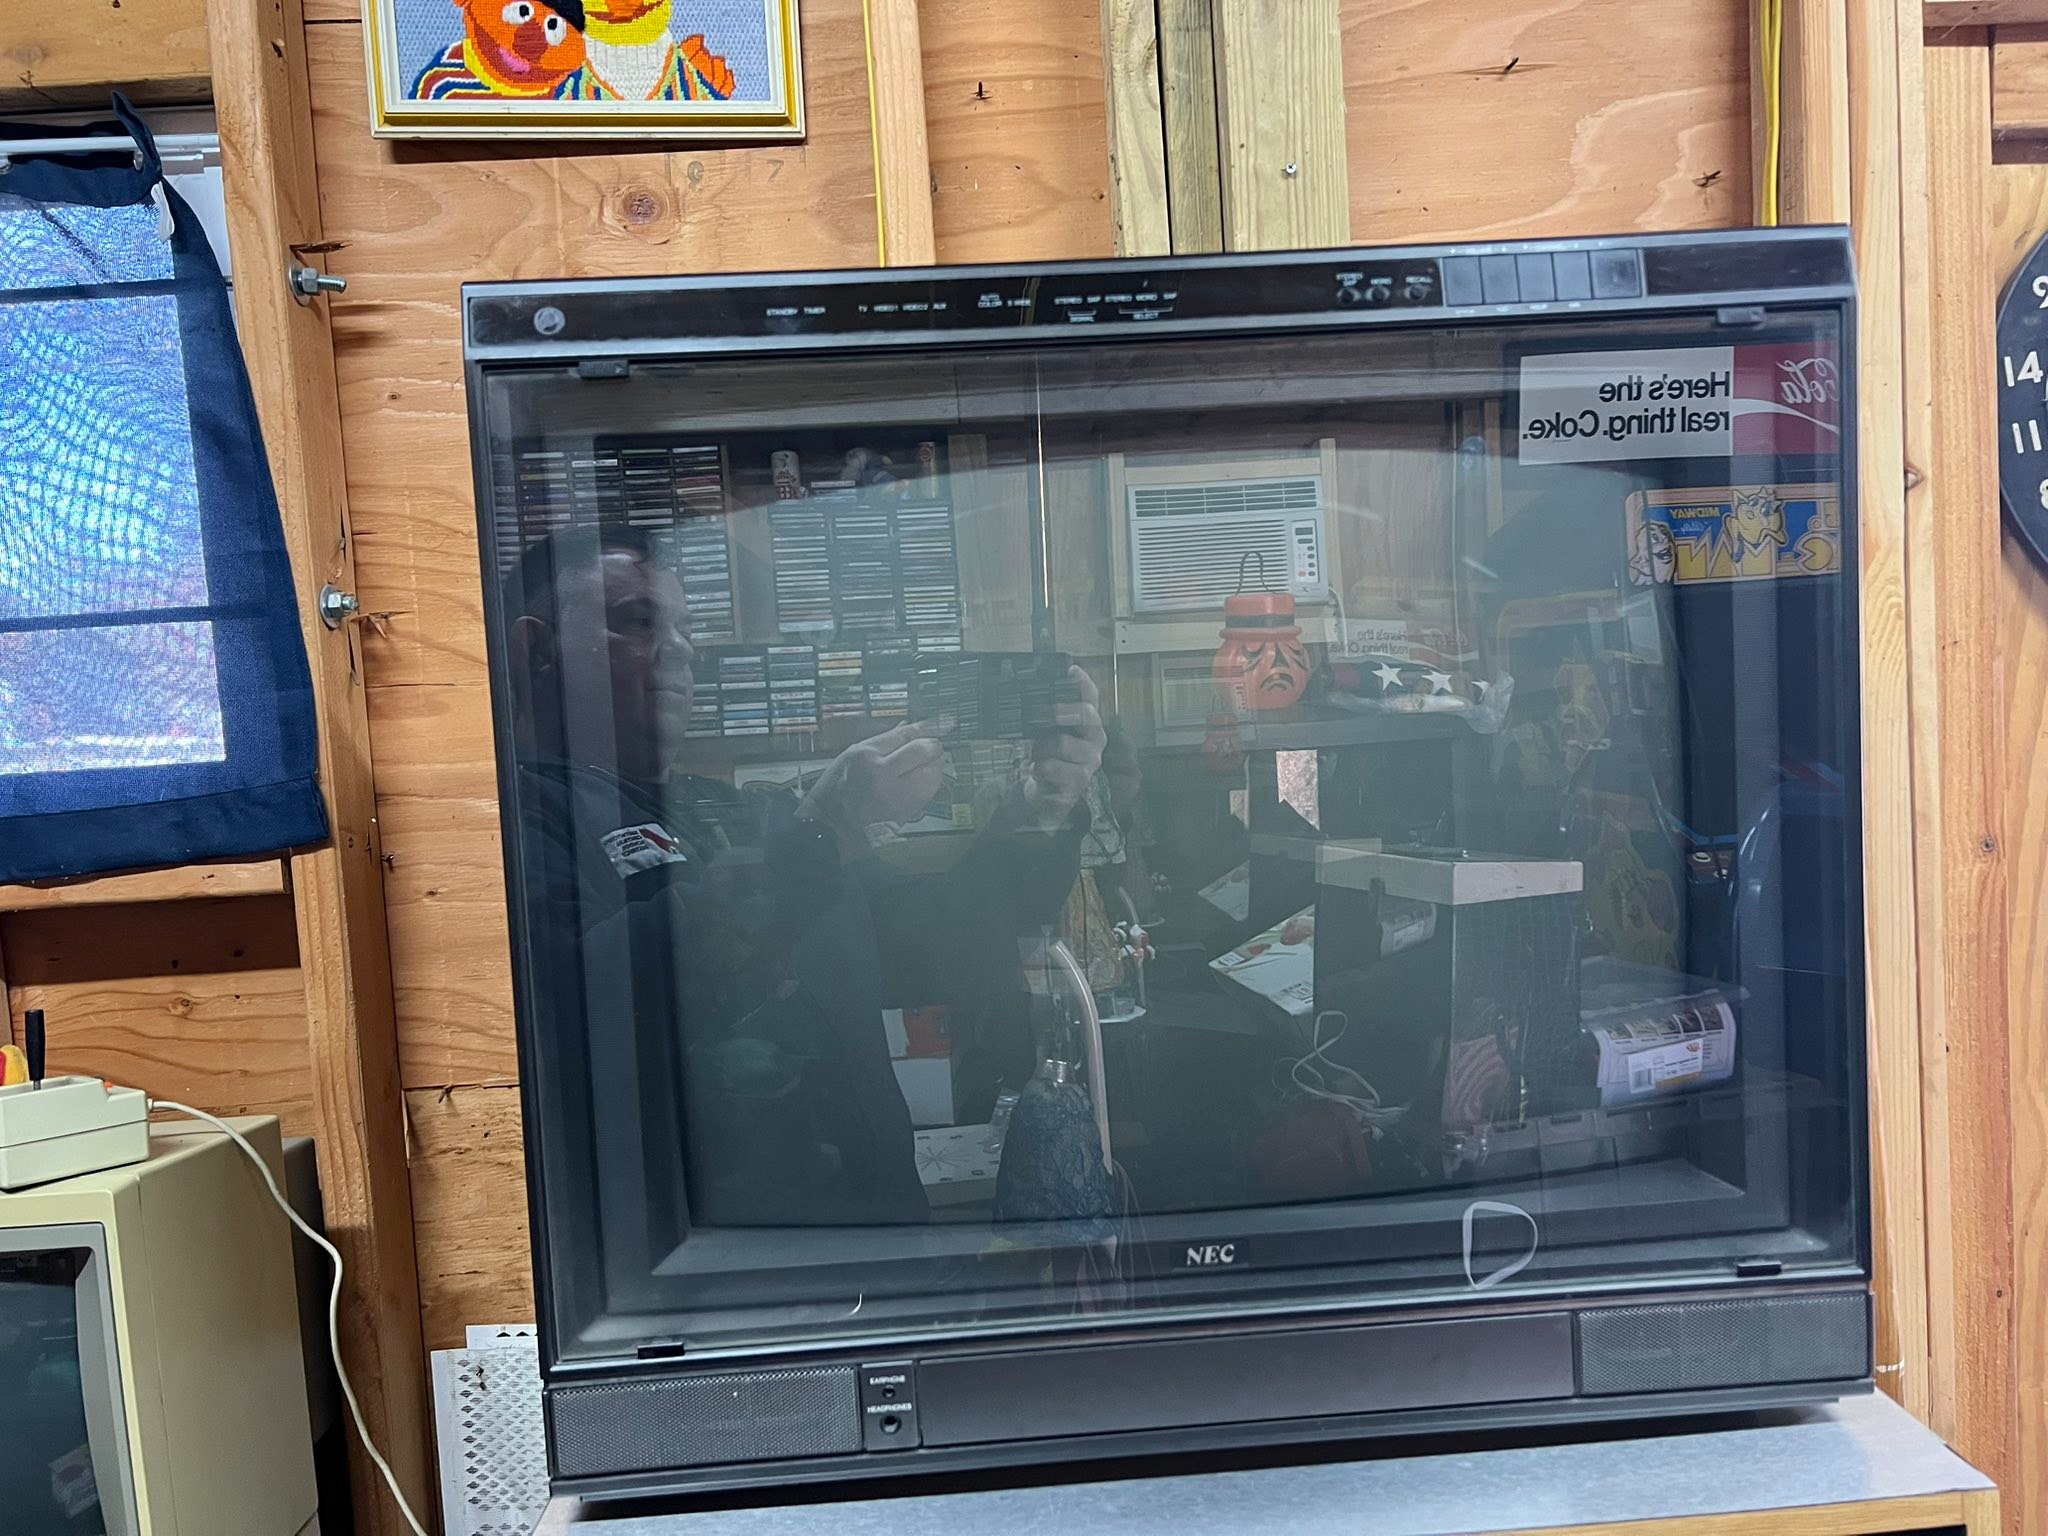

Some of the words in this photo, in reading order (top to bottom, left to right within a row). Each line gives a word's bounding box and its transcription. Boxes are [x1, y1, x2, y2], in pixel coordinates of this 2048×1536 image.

[858, 304, 868, 313] TV
[2003, 350, 2044, 388] 14
[2012, 418, 2042, 454] 11
[1187, 1243, 1234, 1267] NEC
